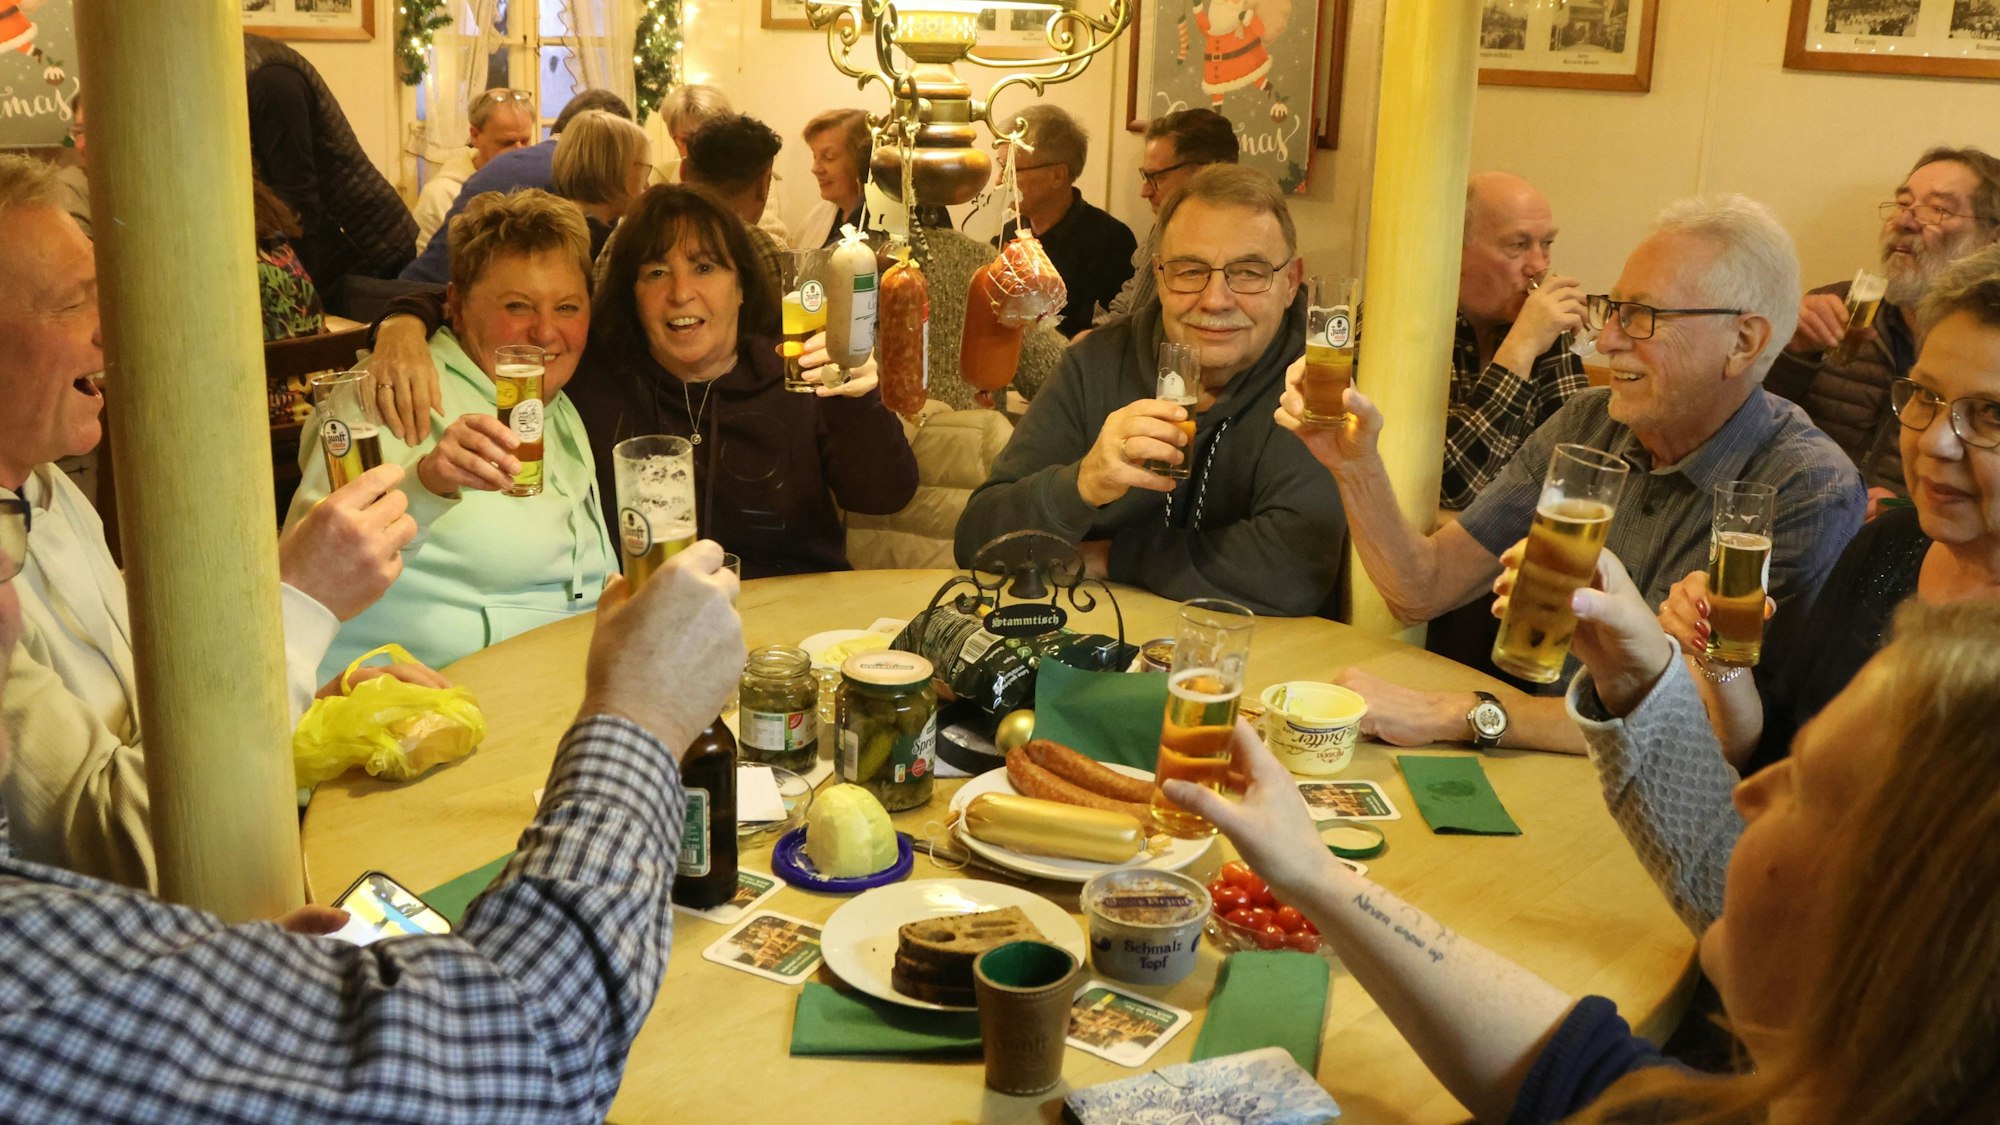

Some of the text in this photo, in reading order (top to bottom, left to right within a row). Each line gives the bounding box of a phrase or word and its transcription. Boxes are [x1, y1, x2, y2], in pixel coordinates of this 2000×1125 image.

[991, 613, 1060, 628] Stammtisch
[1291, 729, 1347, 749] Butter
[1123, 939, 1182, 955] Schmalz
[1138, 955, 1169, 971] Topf
